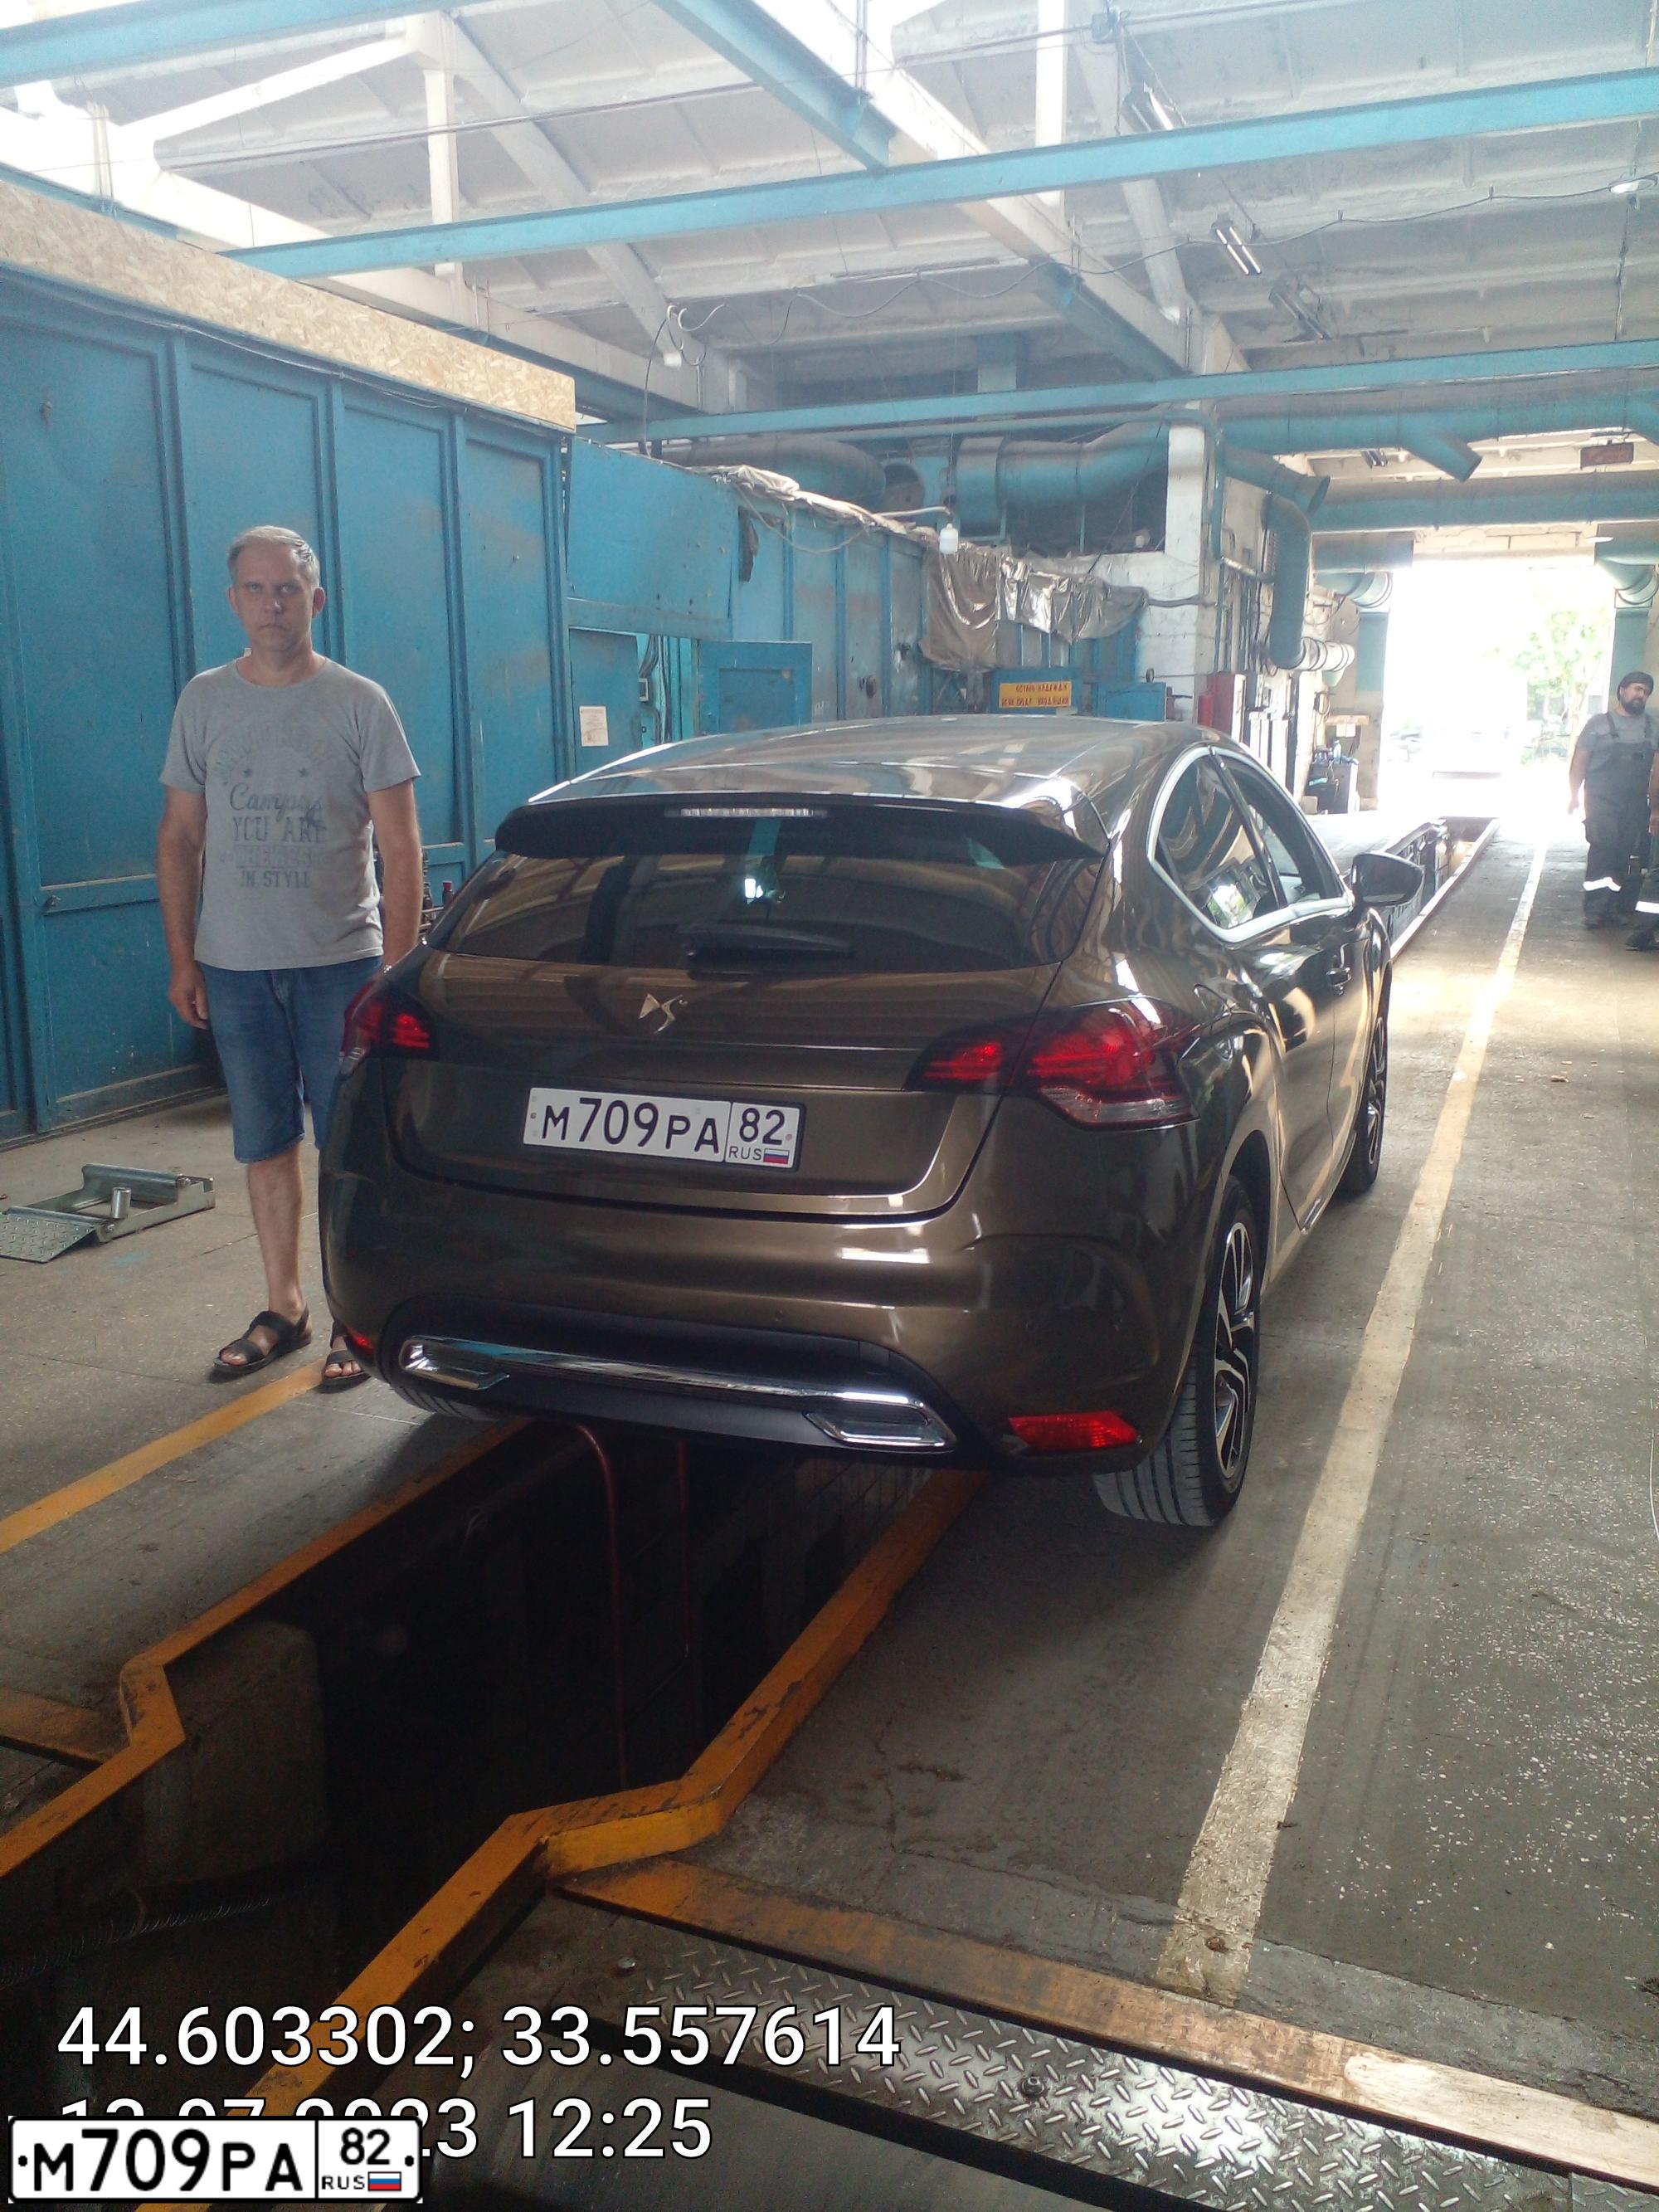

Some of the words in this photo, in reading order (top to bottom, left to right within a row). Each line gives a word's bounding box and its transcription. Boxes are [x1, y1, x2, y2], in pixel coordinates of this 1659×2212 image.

[232, 816, 268, 842] YOU
[738, 1107, 786, 1146] 82
[727, 1145, 762, 1162] RUS
